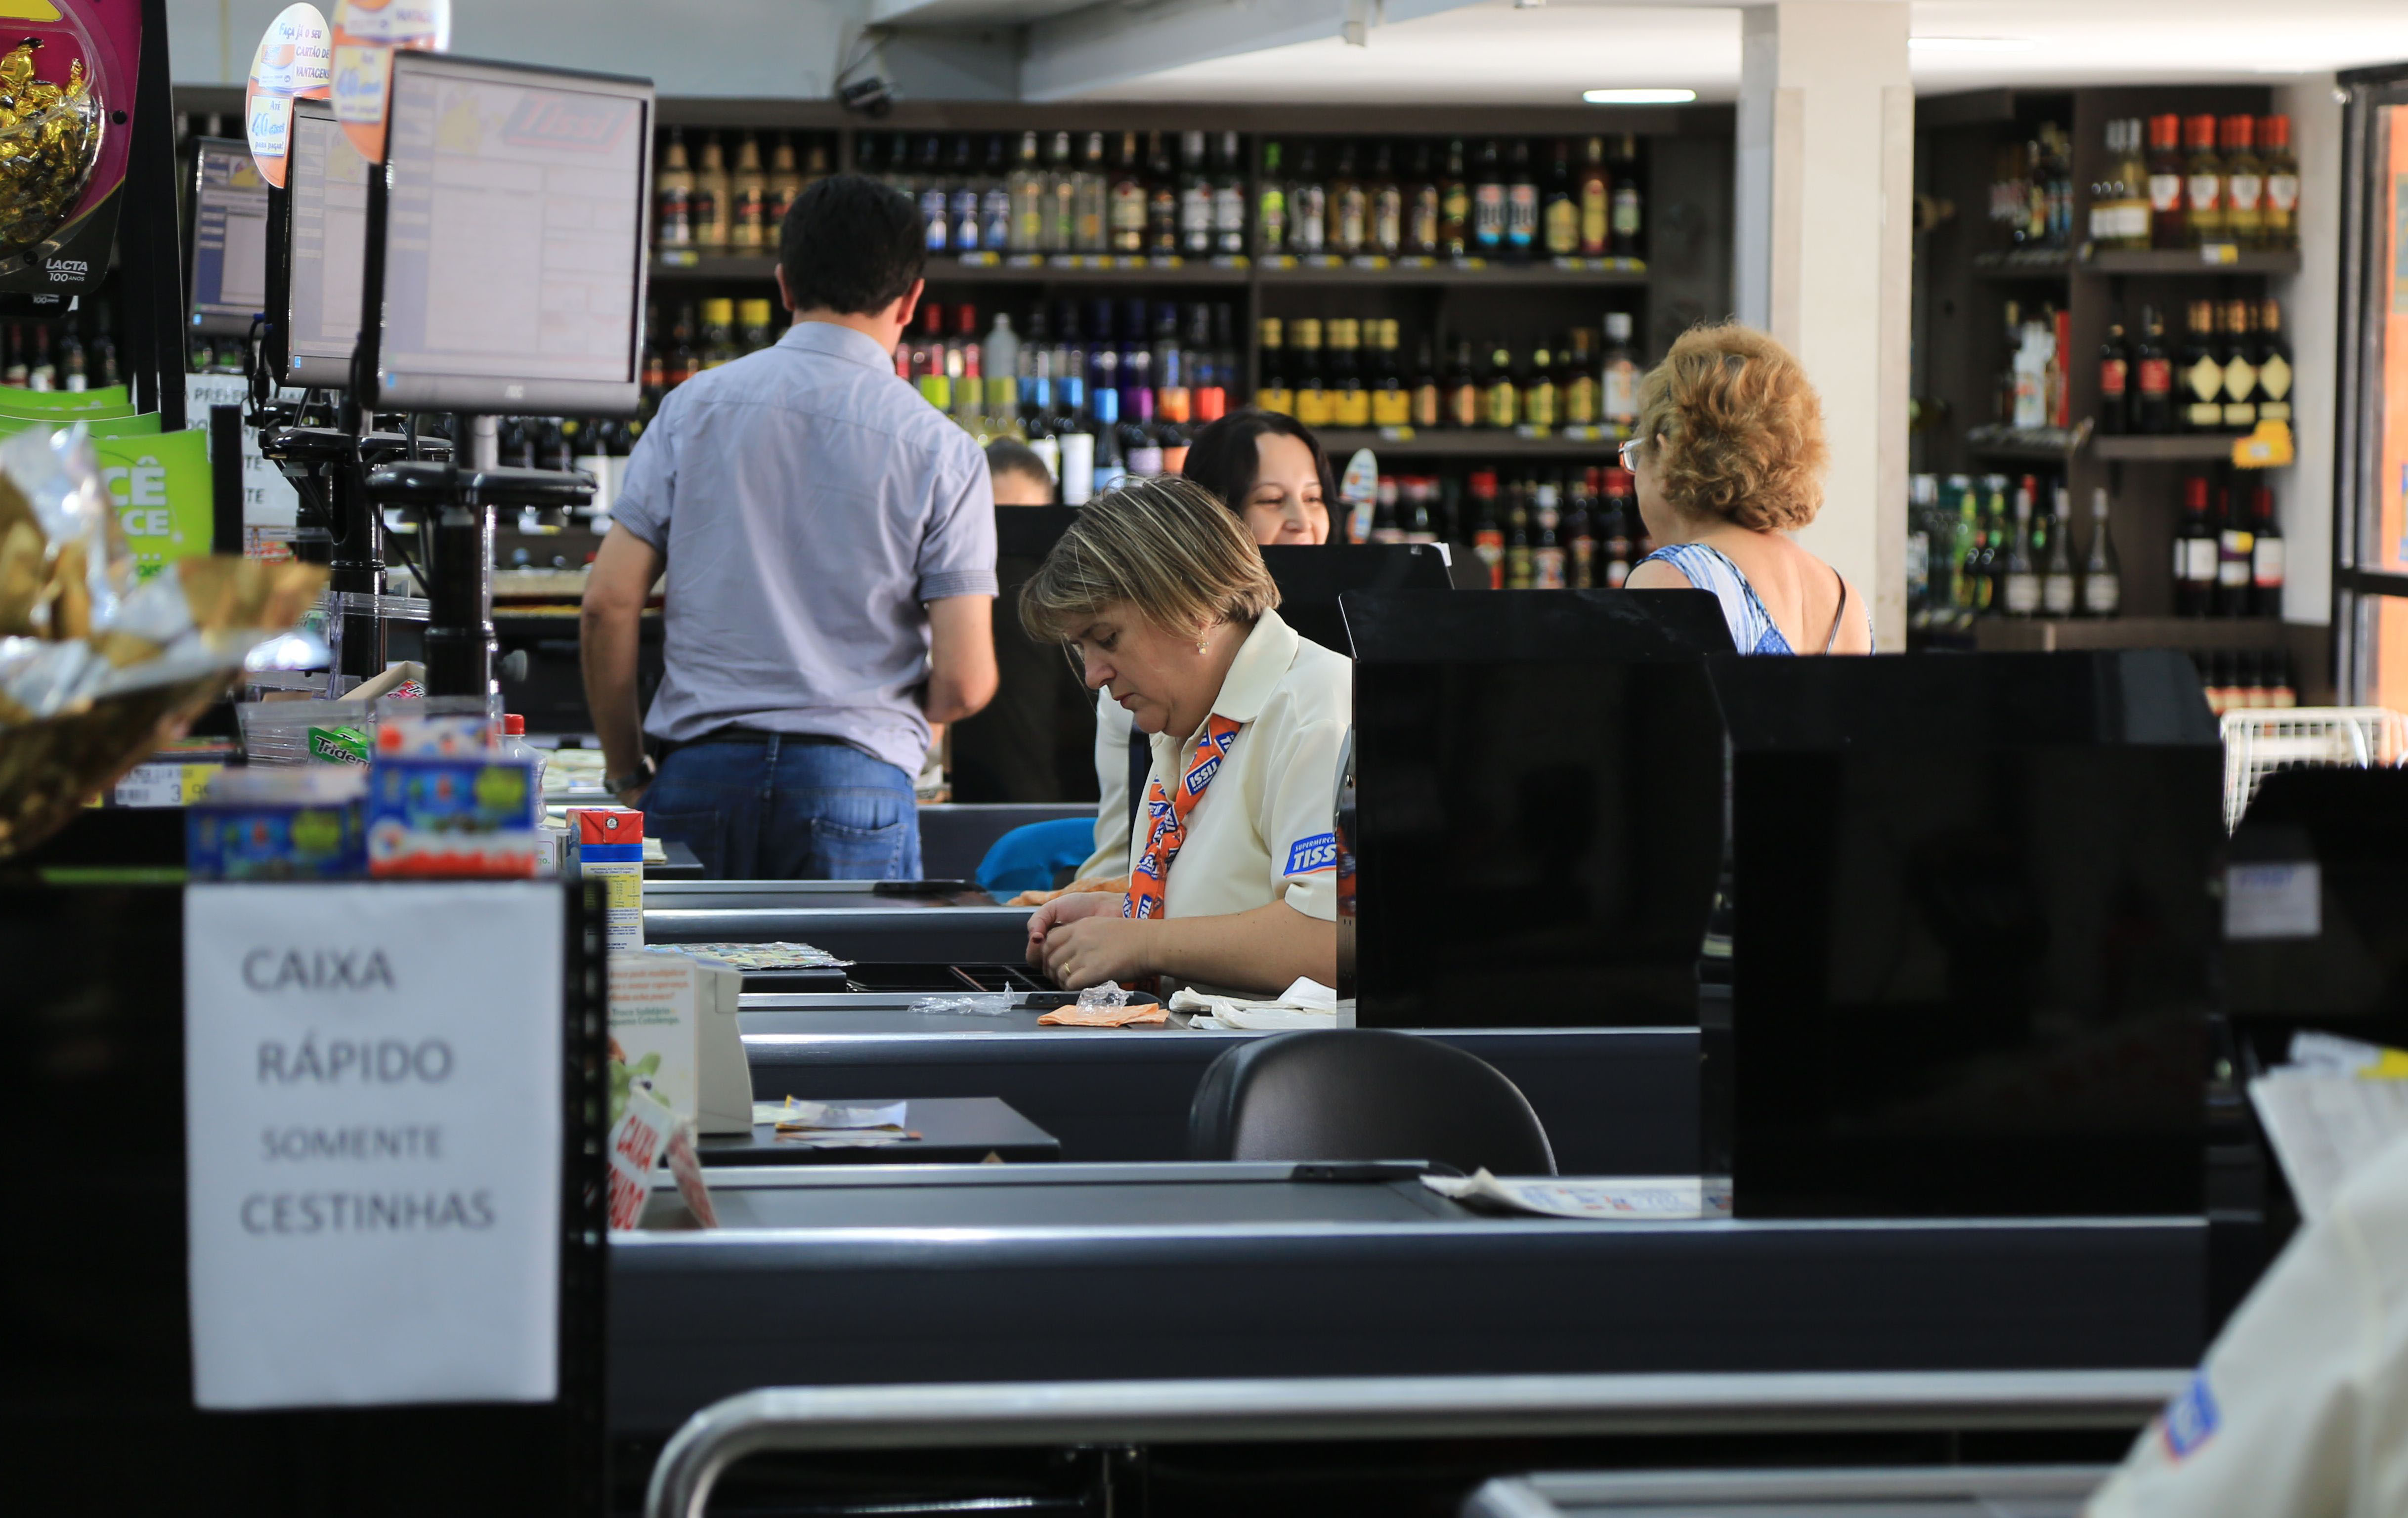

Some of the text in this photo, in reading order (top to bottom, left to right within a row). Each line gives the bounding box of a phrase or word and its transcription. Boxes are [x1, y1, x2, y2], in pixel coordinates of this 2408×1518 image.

[296, 45, 330, 58] CARTÃO DE
[297, 66, 330, 79] VANTAGENS
[252, 113, 269, 136] 40
[45, 258, 87, 271] LACTA
[50, 273, 68, 281] 100
[245, 455, 262, 470] TE
[102, 456, 166, 507] CÊ
[246, 487, 264, 504] TE
[122, 509, 169, 536] CE
[315, 735, 370, 768] Triden
[1295, 837, 1336, 852] SUPERMERCA
[1292, 843, 1336, 871] TISS
[1139, 899, 1152, 919] TIS
[242, 947, 396, 993] CAIXA
[257, 1029, 454, 1085] RÁPIDO
[260, 1125, 443, 1161] SOMENTE
[240, 1189, 496, 1236] CESTINHAS
